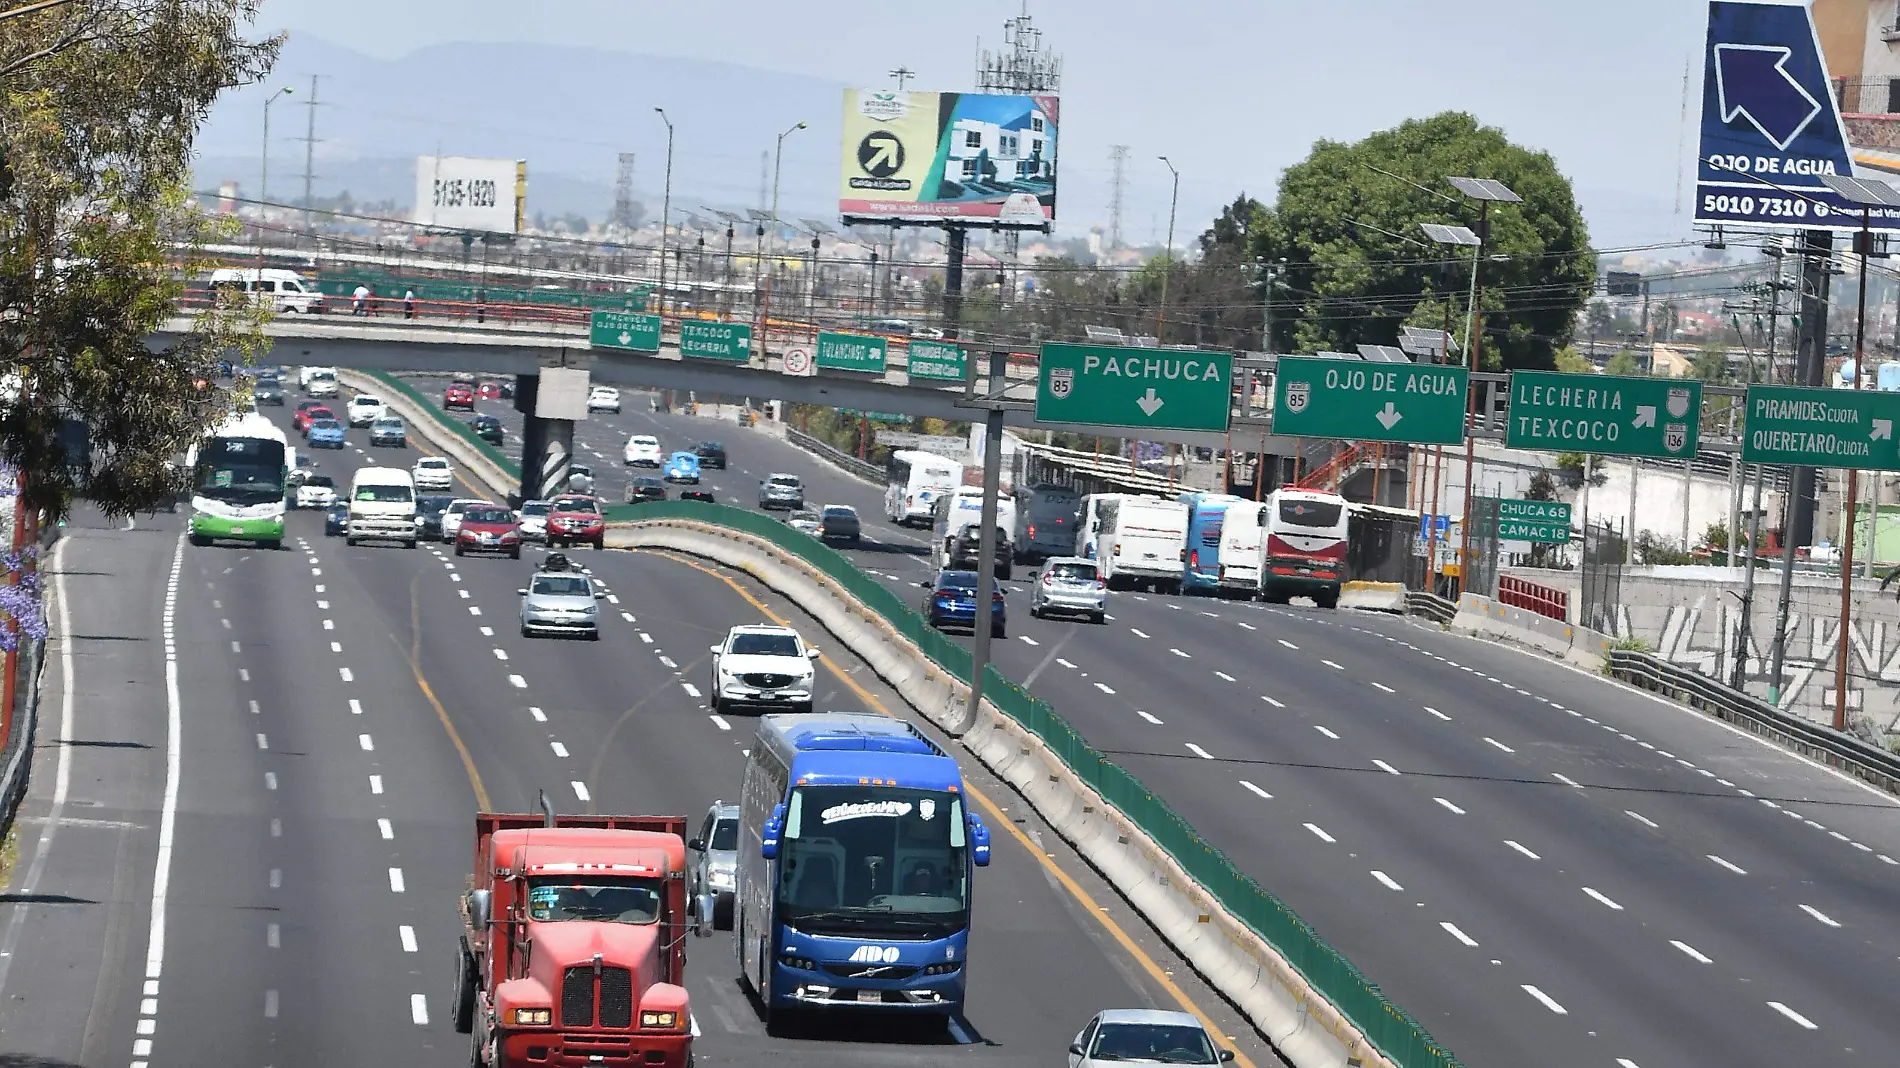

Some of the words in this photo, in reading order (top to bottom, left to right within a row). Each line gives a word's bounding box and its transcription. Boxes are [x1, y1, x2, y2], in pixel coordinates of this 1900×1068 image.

[1709, 154, 1751, 172] OJO
[1754, 156, 1780, 174] DE
[1783, 158, 1836, 176] AGUA
[1704, 194, 1755, 215] 5010
[1758, 197, 1808, 217] 7310
[682, 325, 732, 340] TEXCOCO
[681, 340, 731, 355] LECHERIA
[1083, 355, 1220, 382] PACHUCA
[1053, 379, 1068, 393] 85
[1325, 369, 1366, 391] OJO
[1372, 371, 1398, 392] DE
[1404, 373, 1458, 396] AGUA
[1289, 394, 1305, 407] 85
[1520, 385, 1622, 411] LECHERIA
[1755, 398, 1827, 422] PIRAMIDES
[1827, 408, 1859, 423] CUOTA
[1519, 416, 1619, 442] TEXCOCO
[1667, 434, 1682, 447] 136
[1753, 430, 1836, 455] QUERETARO
[1836, 440, 1869, 456] CUOTA
[1548, 507, 1567, 518] 68
[1483, 522, 1547, 538] TCAMAC
[1551, 528, 1566, 539] 18
[848, 945, 900, 963] ADO
